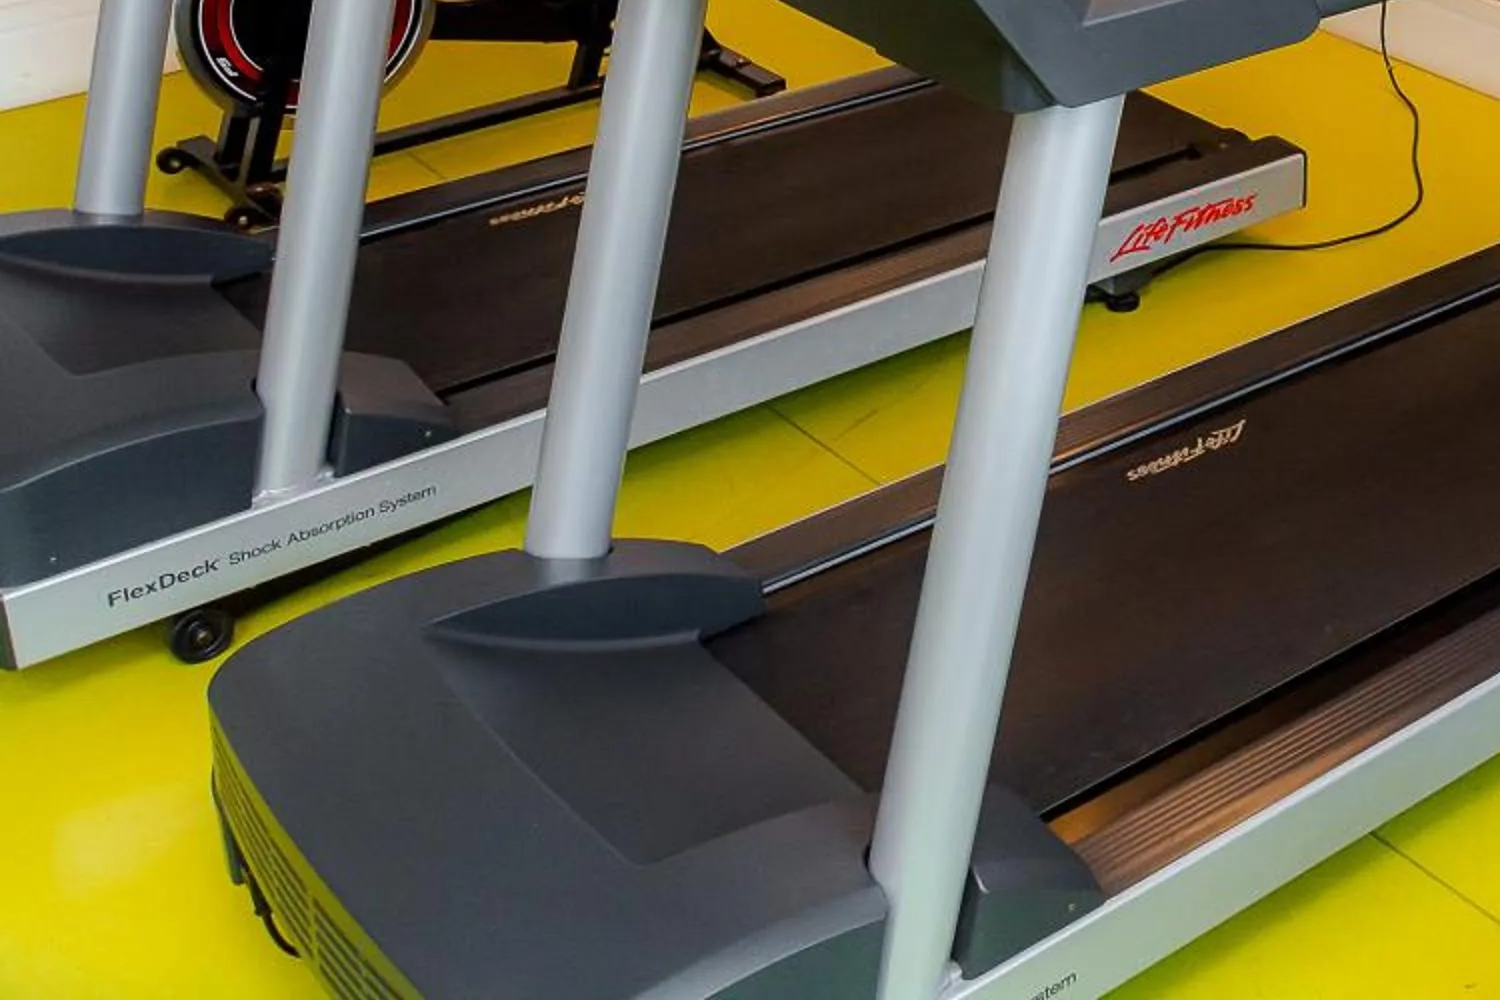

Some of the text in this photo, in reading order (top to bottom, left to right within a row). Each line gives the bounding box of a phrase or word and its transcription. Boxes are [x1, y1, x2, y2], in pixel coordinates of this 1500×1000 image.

[107, 485, 437, 608] FlexDeck Shock Absorption System
